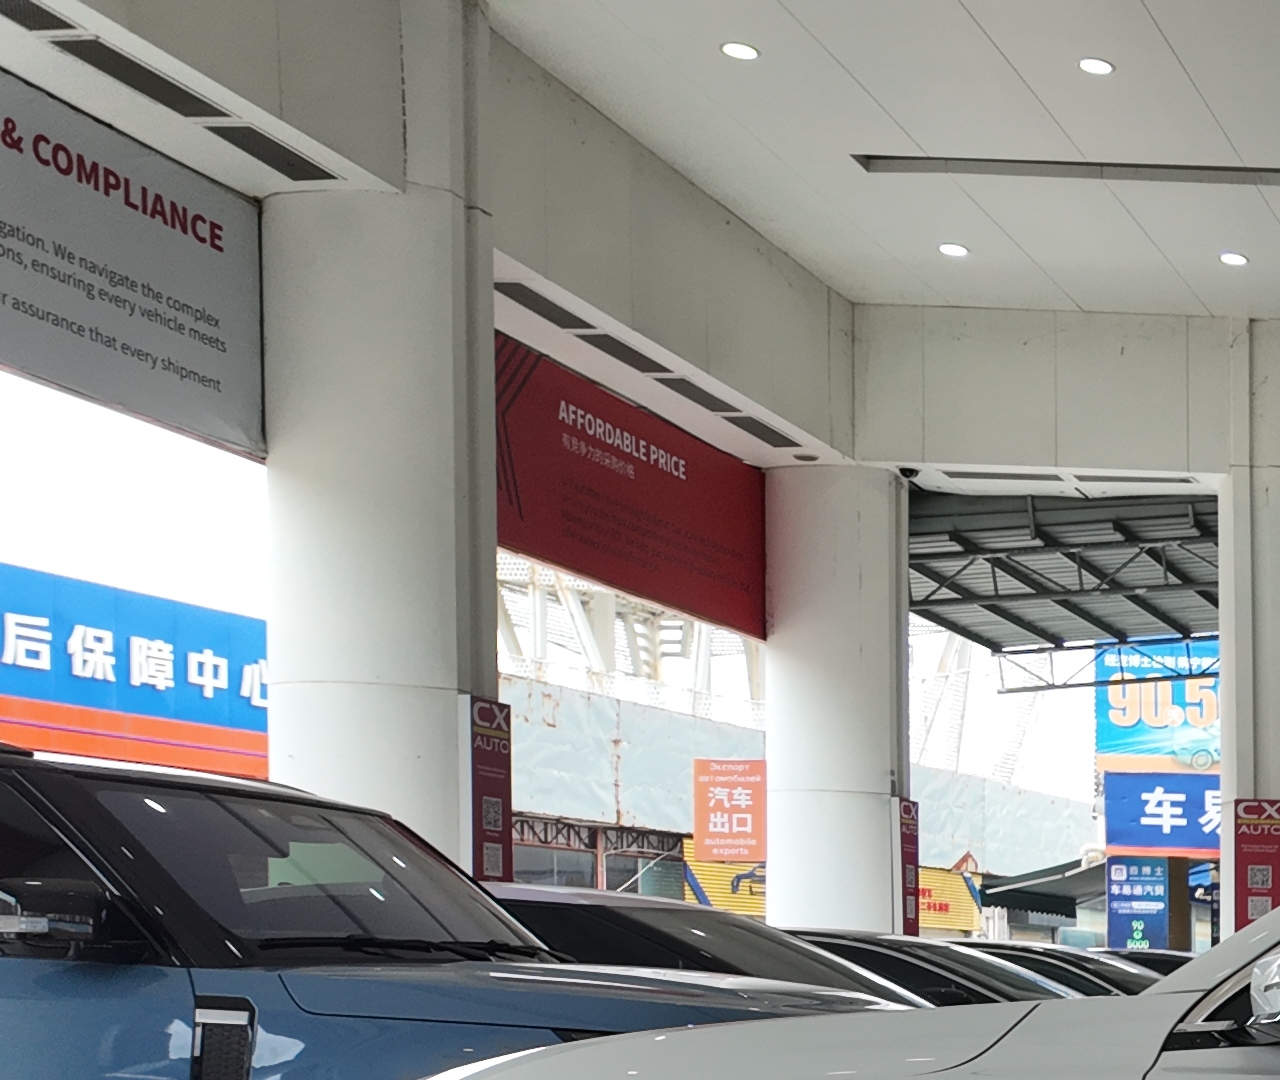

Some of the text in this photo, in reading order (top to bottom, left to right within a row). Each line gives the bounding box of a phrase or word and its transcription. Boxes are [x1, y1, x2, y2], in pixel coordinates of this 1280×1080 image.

[1, 117, 224, 253] & COMPLIANCE
[31, 259, 96, 301] ensuring
[98, 288, 137, 317] every
[139, 305, 186, 335] vehicle
[189, 327, 227, 353] meets
[52, 241, 76, 265] We
[79, 257, 138, 294] navigate
[141, 282, 163, 304] the
[166, 296, 221, 330] complex
[12, 297, 86, 338] assurance
[89, 327, 118, 352] that
[121, 342, 158, 370] every
[161, 357, 222, 393] shipment
[559, 400, 687, 480] AFFORDABLE PRICE
[473, 701, 509, 731] CX
[474, 735, 510, 754] AUTO
[708, 786, 753, 808] 汽车
[708, 811, 753, 834] 出口
[901, 801, 918, 820] CX
